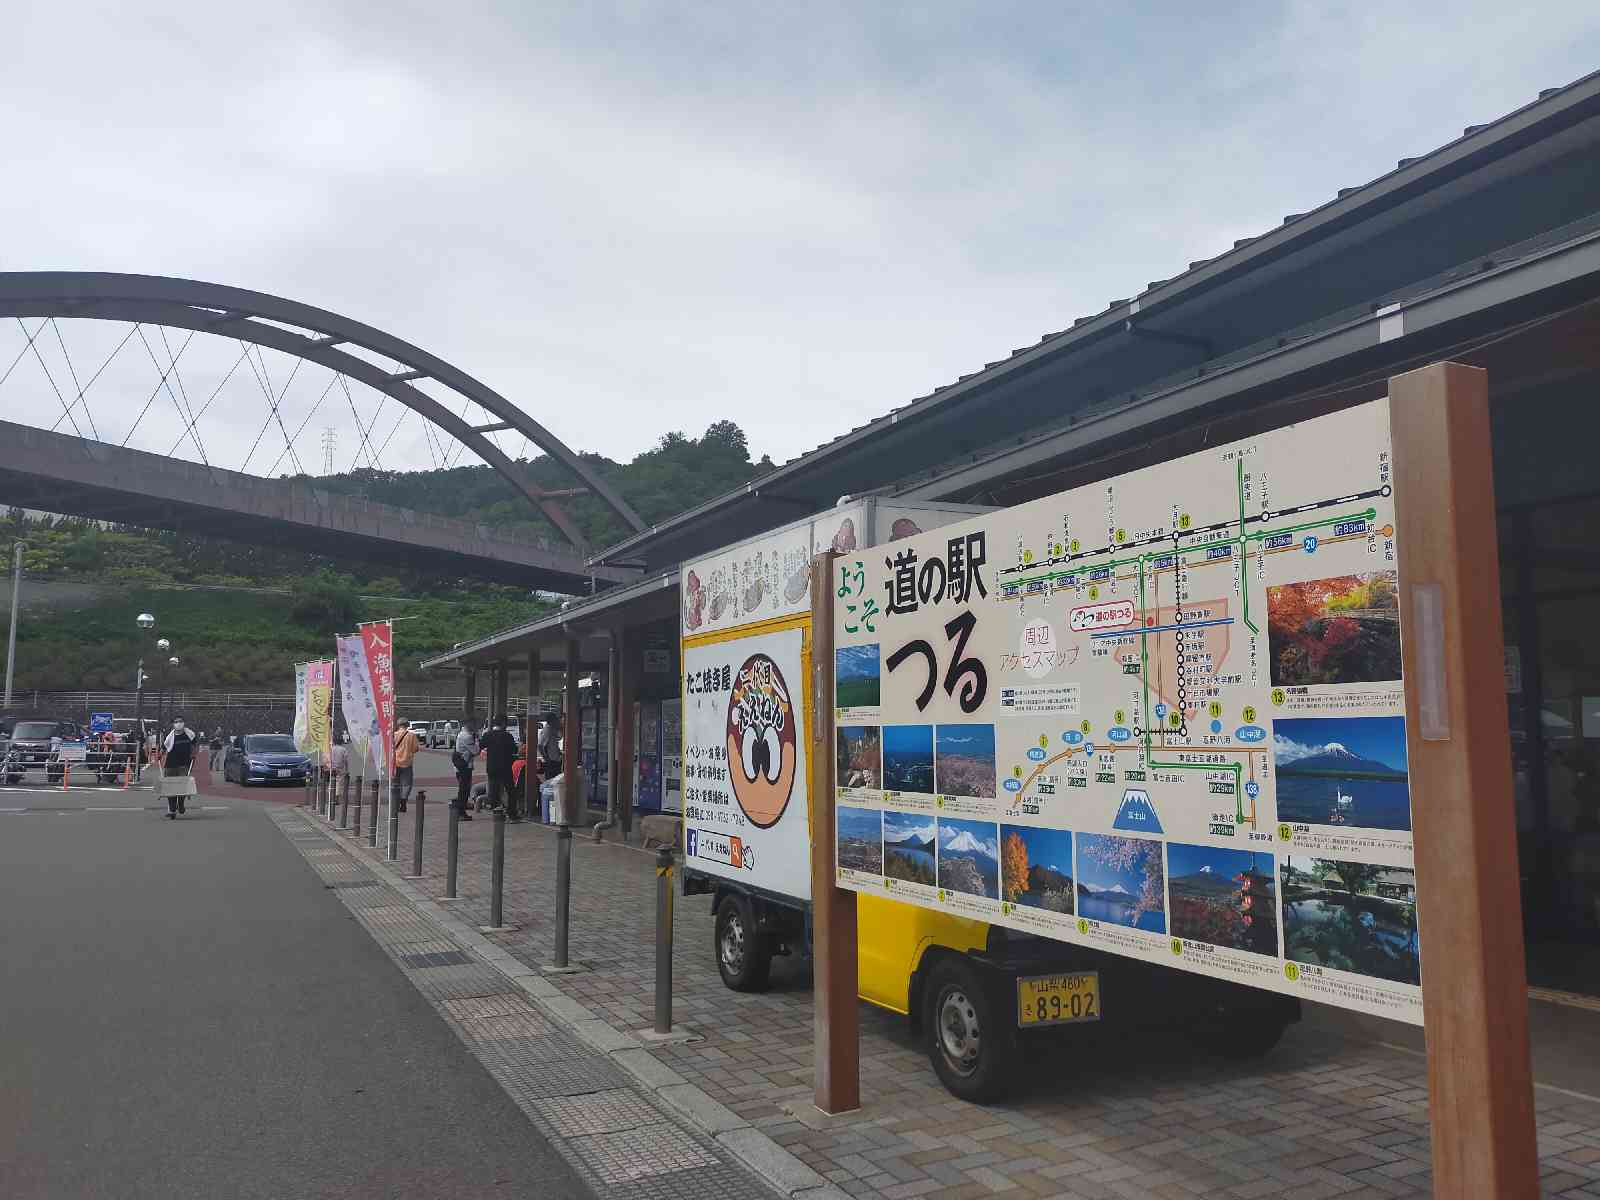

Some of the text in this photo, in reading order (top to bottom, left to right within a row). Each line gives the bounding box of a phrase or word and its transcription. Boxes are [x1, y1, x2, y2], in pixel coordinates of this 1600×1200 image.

[1379, 452, 1389, 482] 新宿駅
[1384, 539, 1393, 561] 新宿
[837, 561, 866, 598] よう
[884, 530, 989, 618] 道の駅
[844, 598, 880, 633] こそ
[1096, 608, 1131, 621] 道の駅つる
[1026, 626, 1049, 645] 周辺
[886, 609, 988, 714] つる
[1000, 646, 1080, 671] アクセスマップ
[686, 664, 731, 695] たこ焼き屋
[741, 661, 771, 689] 二代目
[1127, 811, 1146, 820] 富士山
[1036, 992, 1095, 1019] 89-02
